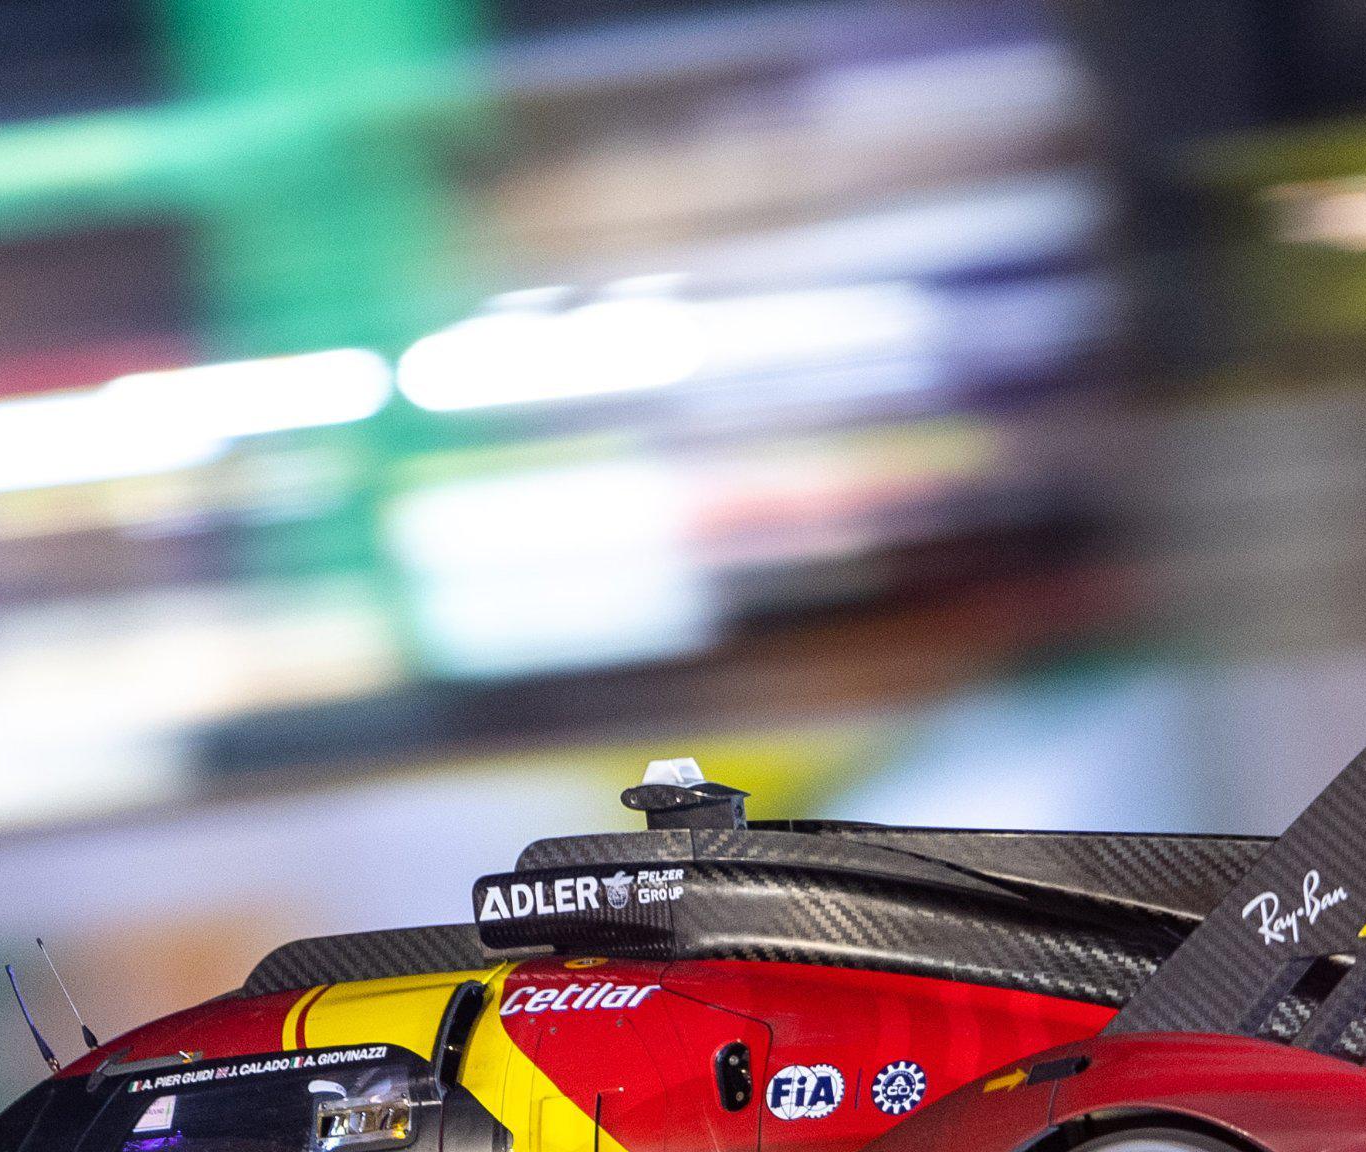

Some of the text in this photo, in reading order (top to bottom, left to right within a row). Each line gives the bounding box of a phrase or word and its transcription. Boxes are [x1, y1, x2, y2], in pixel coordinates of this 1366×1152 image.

[479, 875, 600, 922] ADLER
[142, 1076, 153, 1091] A.
[154, 1071, 180, 1088] PIER
[182, 1068, 214, 1085] GUIDI
[239, 1059, 289, 1076] CALADO
[303, 1053, 316, 1067] A.
[318, 1046, 387, 1065] GIOVINAZZI
